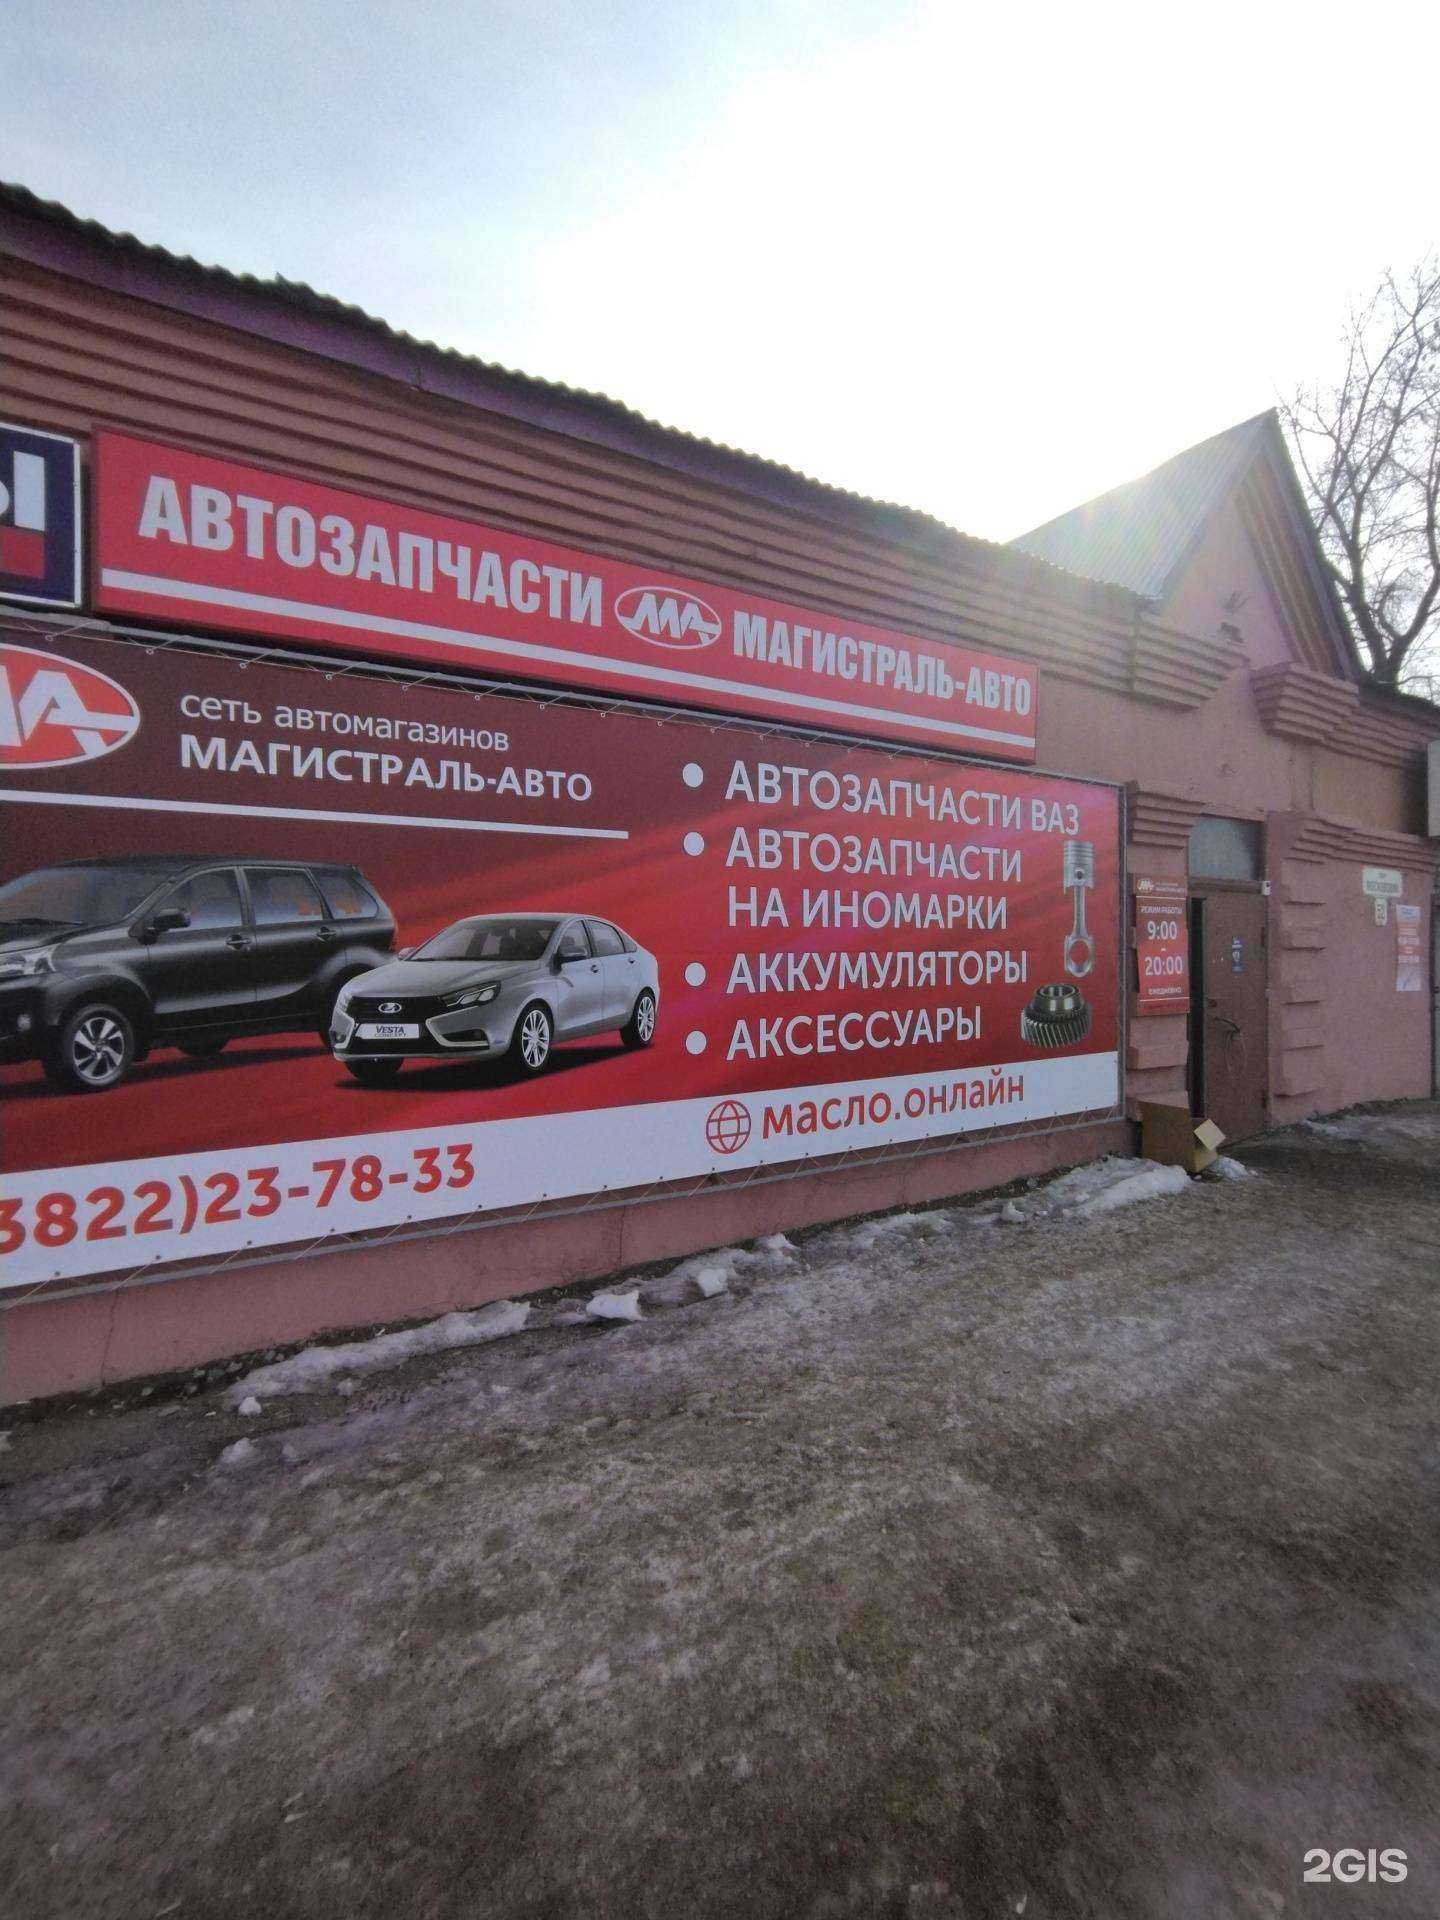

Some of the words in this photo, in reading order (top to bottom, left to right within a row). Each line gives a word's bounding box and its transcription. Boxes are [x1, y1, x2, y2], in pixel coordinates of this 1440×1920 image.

[138, 475, 603, 627] АВТОЗАПЧАСТИ
[733, 610, 1032, 716] МАГИСТРАЛЬ-АВТО
[180, 691, 262, 724] сеть
[274, 702, 509, 751] автомагазинов
[180, 734, 593, 801] МАГИСТРАЛЬ-АВТО
[724, 760, 1021, 830] АВТОЗАПЧАСТИ
[1031, 801, 1080, 836] ВАЗ
[725, 826, 1022, 882] АВТОЗАПЧАСТИ
[728, 886, 789, 928] НА
[802, 891, 1007, 930] ИНОМАРКИ
[1147, 920, 1177, 940] 9:00
[726, 950, 1028, 993] АККУМУЛЯТОРЫ
[1145, 955, 1183, 976] 20:00
[376, 1025, 405, 1033] VESTA
[727, 1006, 982, 1060] АКСЕССУАРЫ
[762, 1069, 1025, 1139] масло.онлайн
